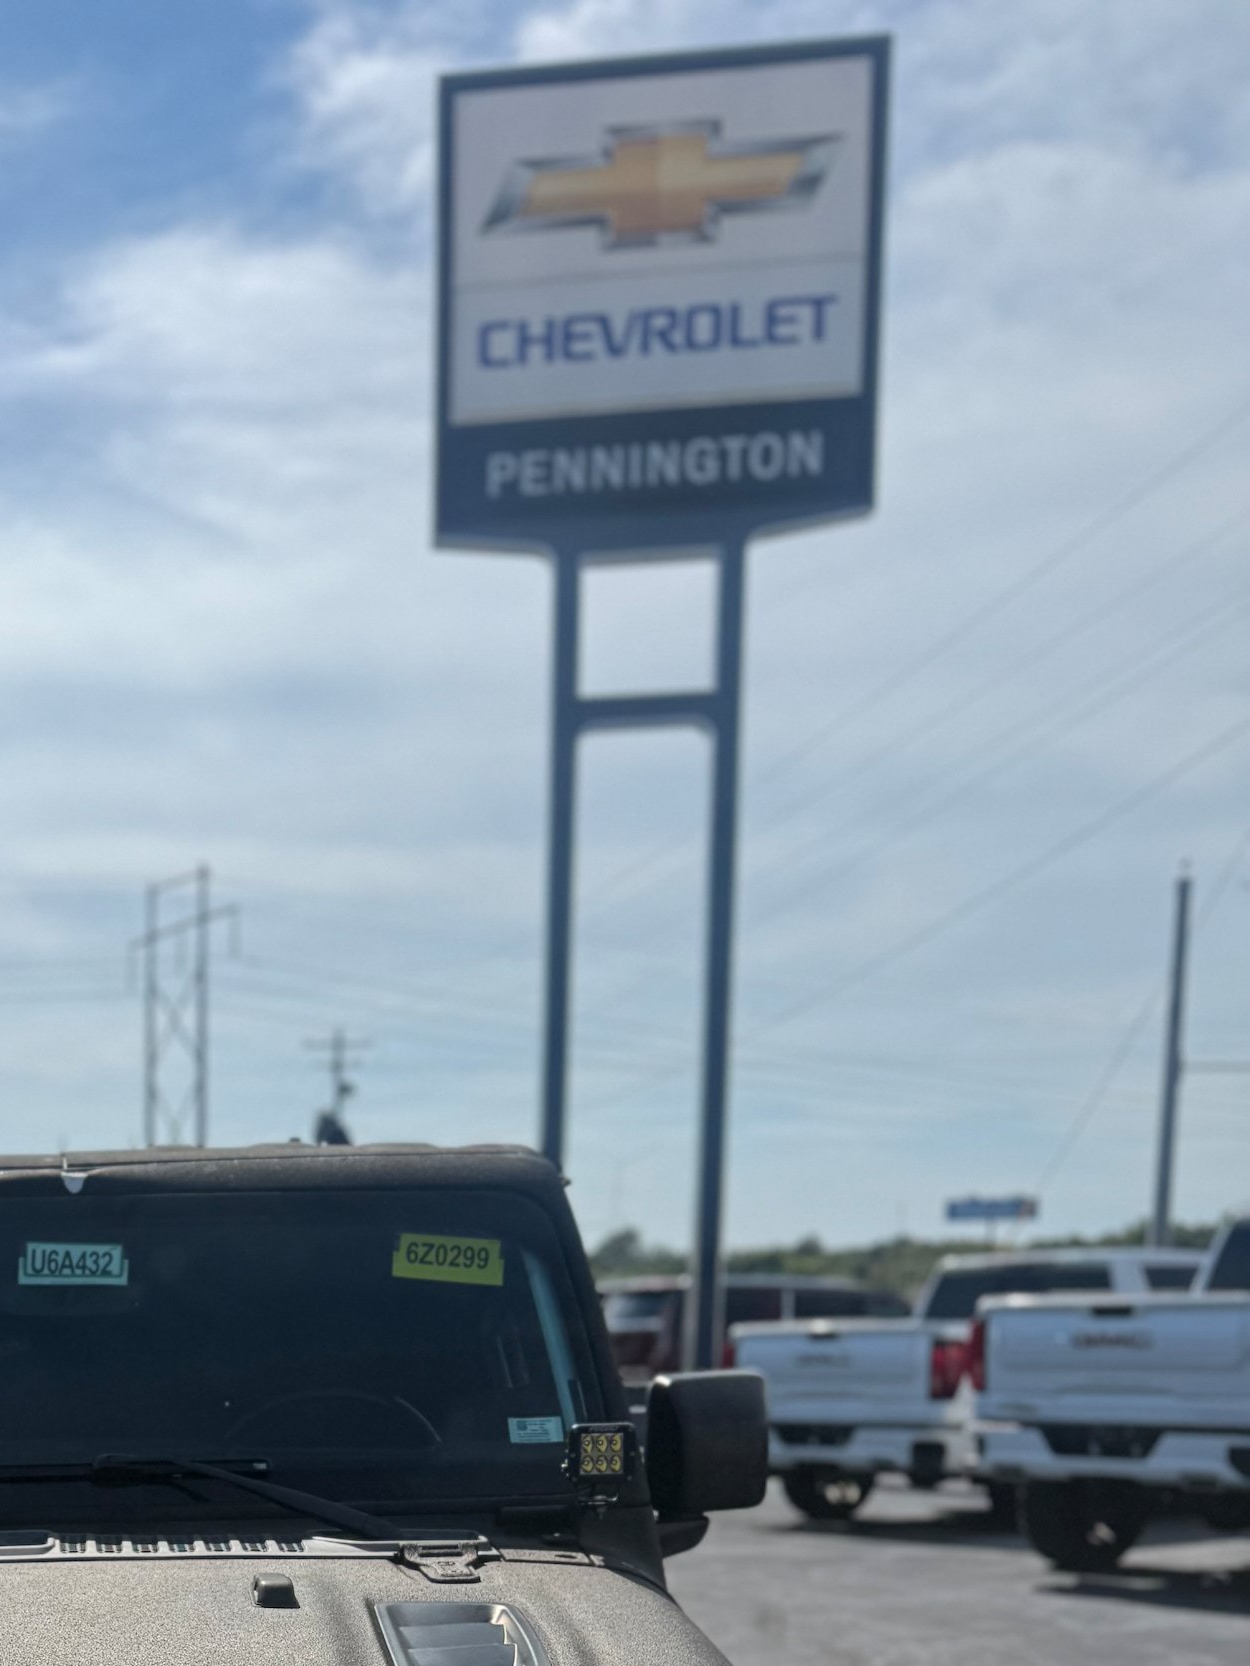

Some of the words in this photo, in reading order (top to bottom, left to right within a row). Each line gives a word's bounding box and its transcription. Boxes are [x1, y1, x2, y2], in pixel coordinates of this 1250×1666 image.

[477, 295, 838, 370] CHEVROLET
[486, 430, 824, 498] PENNINGTON
[31, 1248, 113, 1276] U6A432
[406, 1241, 489, 1269] 6Z0299
